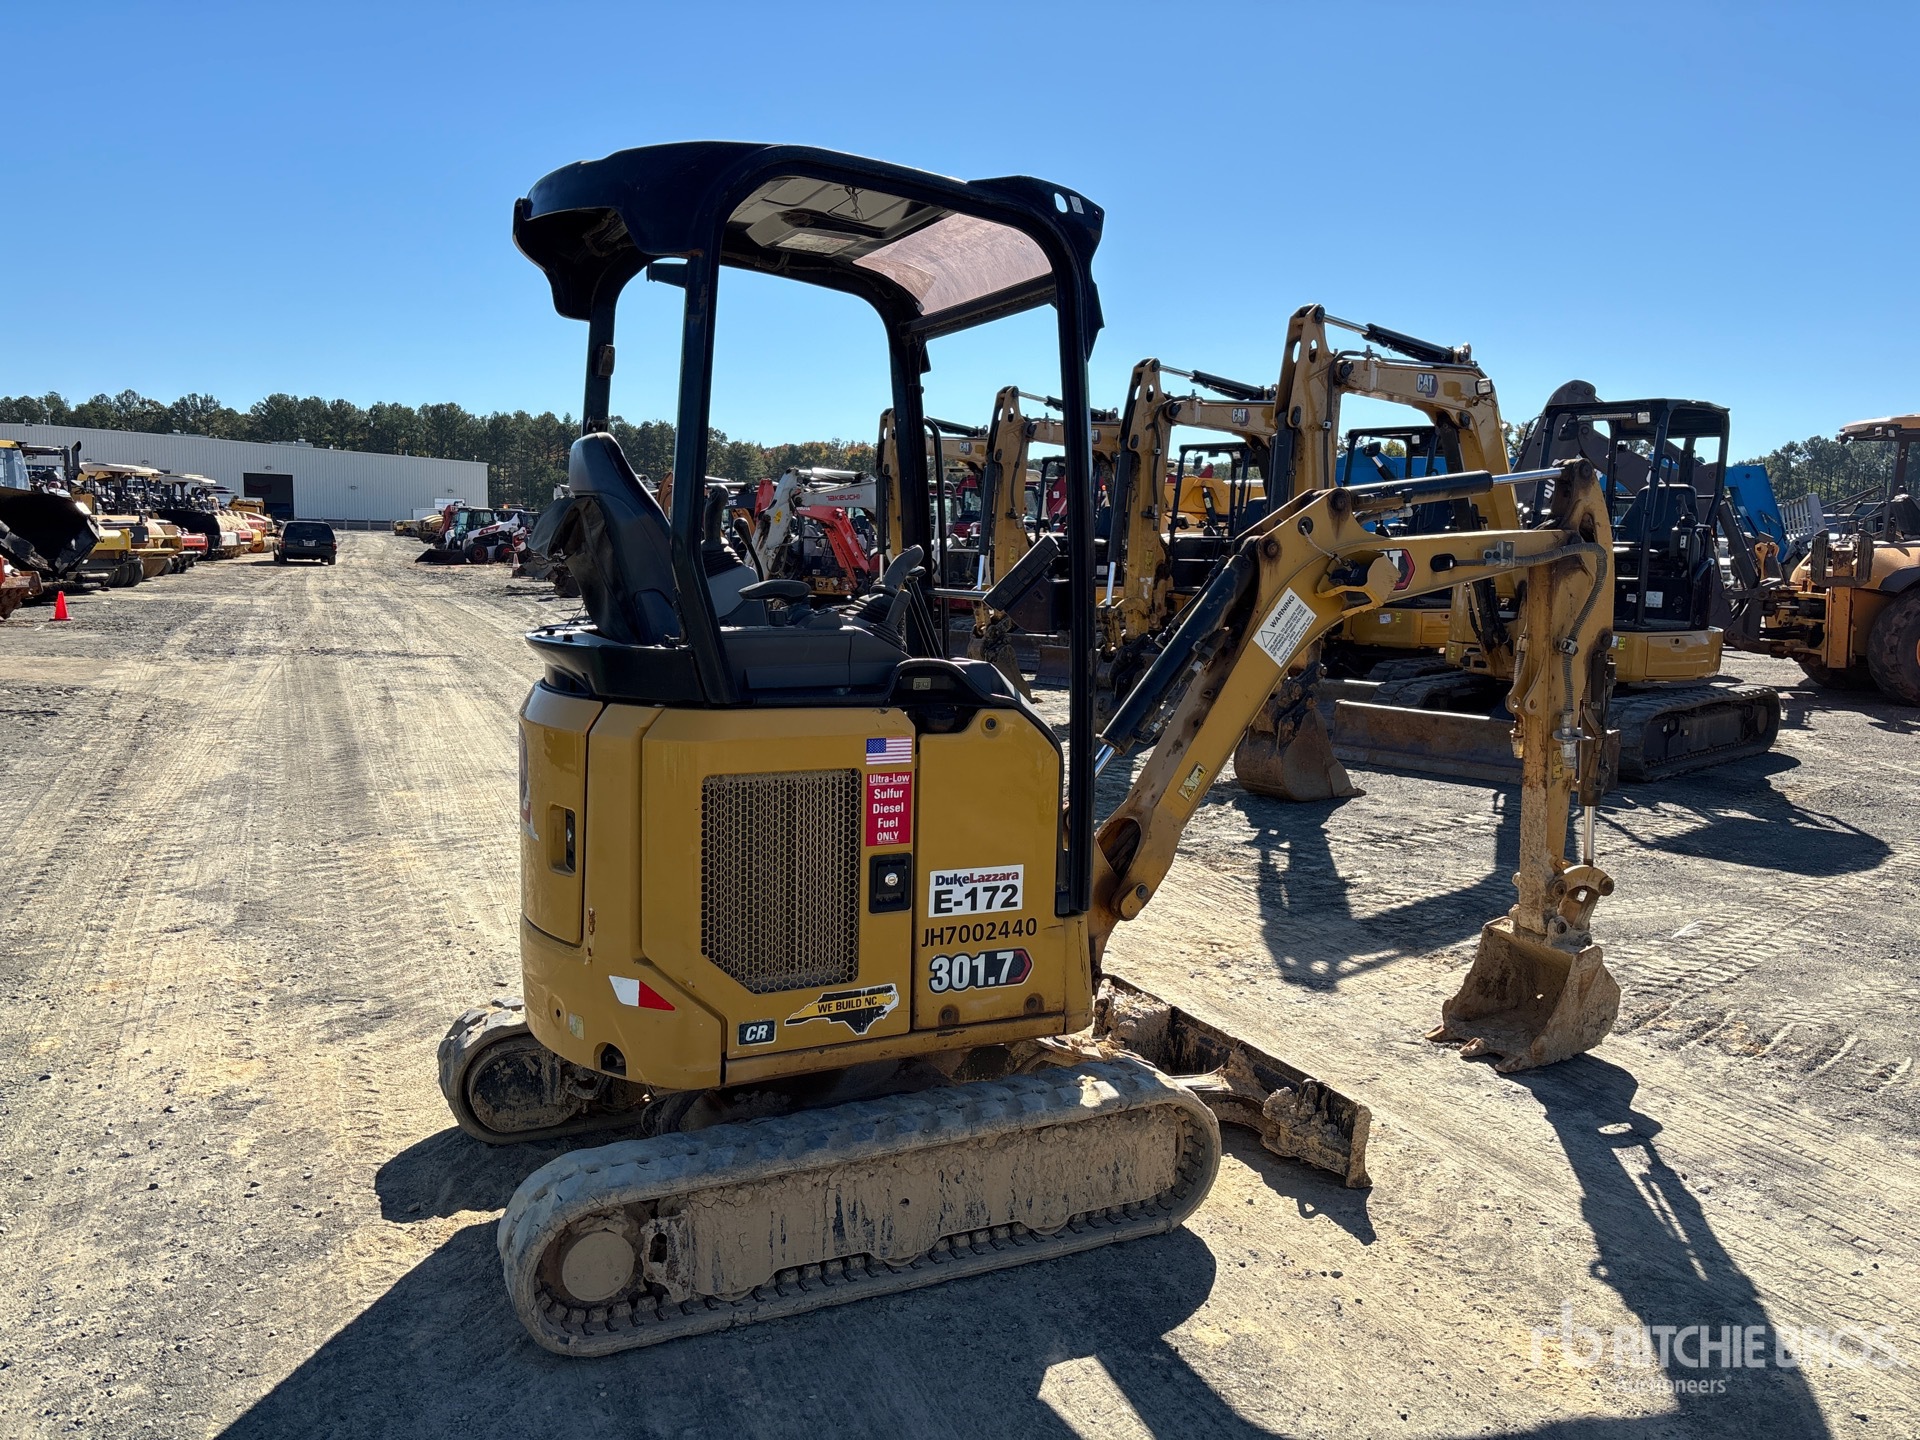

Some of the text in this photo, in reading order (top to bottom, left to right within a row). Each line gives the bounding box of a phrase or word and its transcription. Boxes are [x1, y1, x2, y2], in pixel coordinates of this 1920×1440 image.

[1417, 374, 1434, 392] CAT
[1232, 409, 1246, 422] CAT
[1270, 594, 1295, 627] WARNING
[869, 773, 910, 784] Ultra-Low
[874, 788, 904, 800] Sulfur
[872, 802, 904, 815] Diesel
[877, 817, 899, 829] Fuel
[876, 831, 899, 841] ONLY
[935, 871, 1020, 887] DukeLazzara
[933, 883, 1019, 915] E-172
[921, 917, 1037, 948] JH7002440
[930, 951, 1015, 992] 301.7
[817, 996, 878, 1014] WE BUILD NC
[745, 1025, 768, 1042] CR
